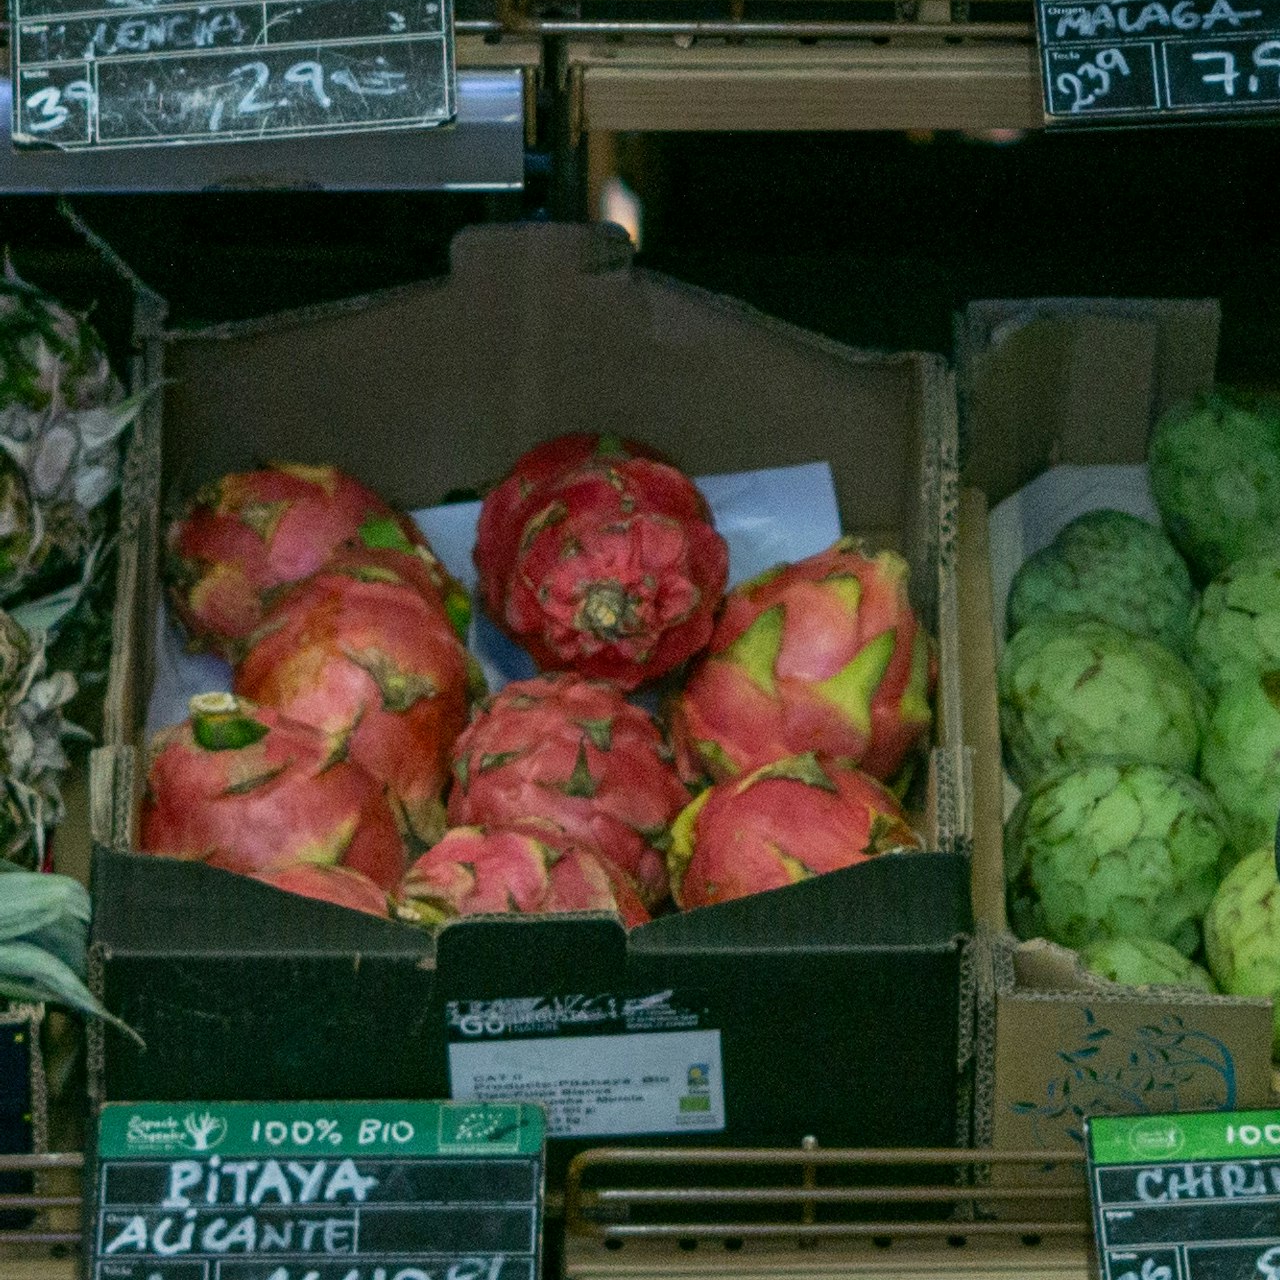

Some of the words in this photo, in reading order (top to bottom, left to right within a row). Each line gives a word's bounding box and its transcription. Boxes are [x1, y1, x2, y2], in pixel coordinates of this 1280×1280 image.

[1057, 48, 1131, 113] 239
[251, 1119, 343, 1145] 100%
[359, 1118, 415, 1143] BIO
[162, 1155, 378, 1208] PITAYA
[106, 1208, 353, 1256] ALICANTE
